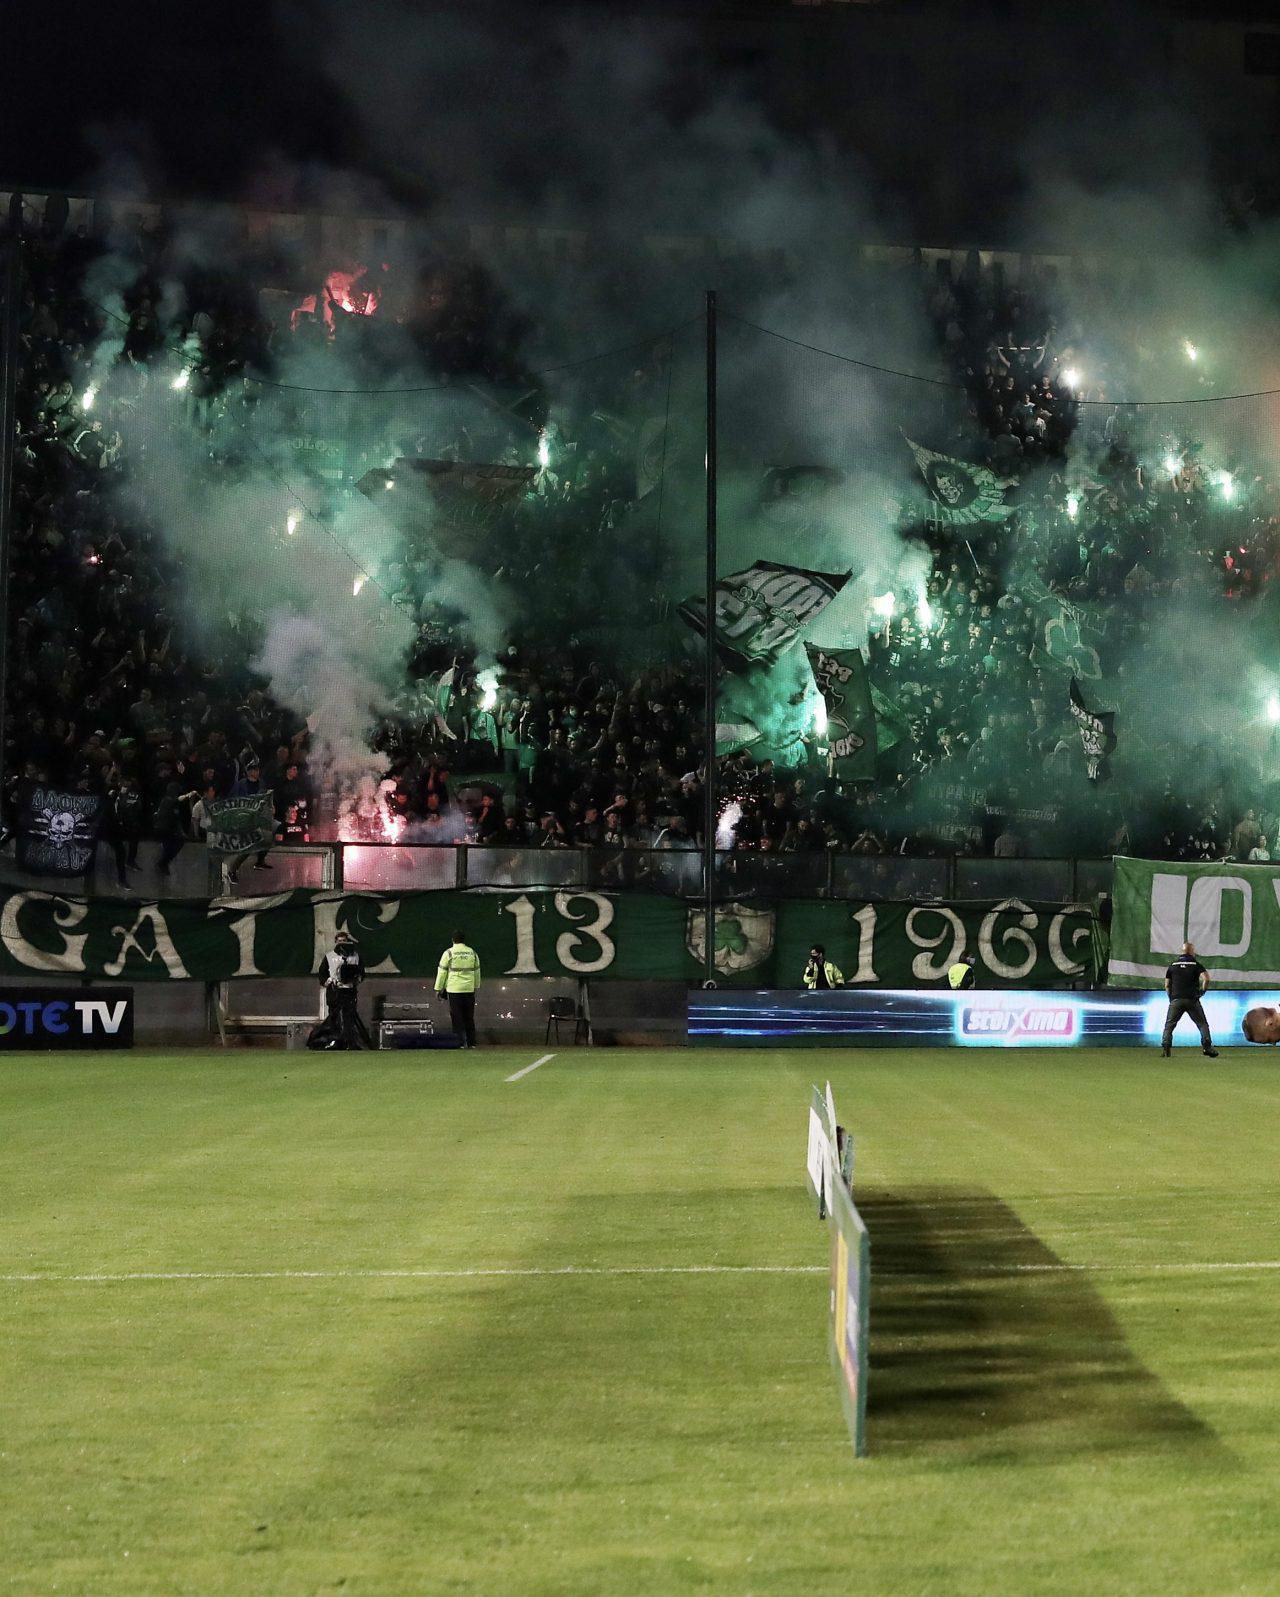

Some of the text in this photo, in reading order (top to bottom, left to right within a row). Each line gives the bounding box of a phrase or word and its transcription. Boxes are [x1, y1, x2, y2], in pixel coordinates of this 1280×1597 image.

[0, 890, 401, 979] GATE
[505, 892, 615, 974] 13
[74, 1001, 128, 1034] TV
